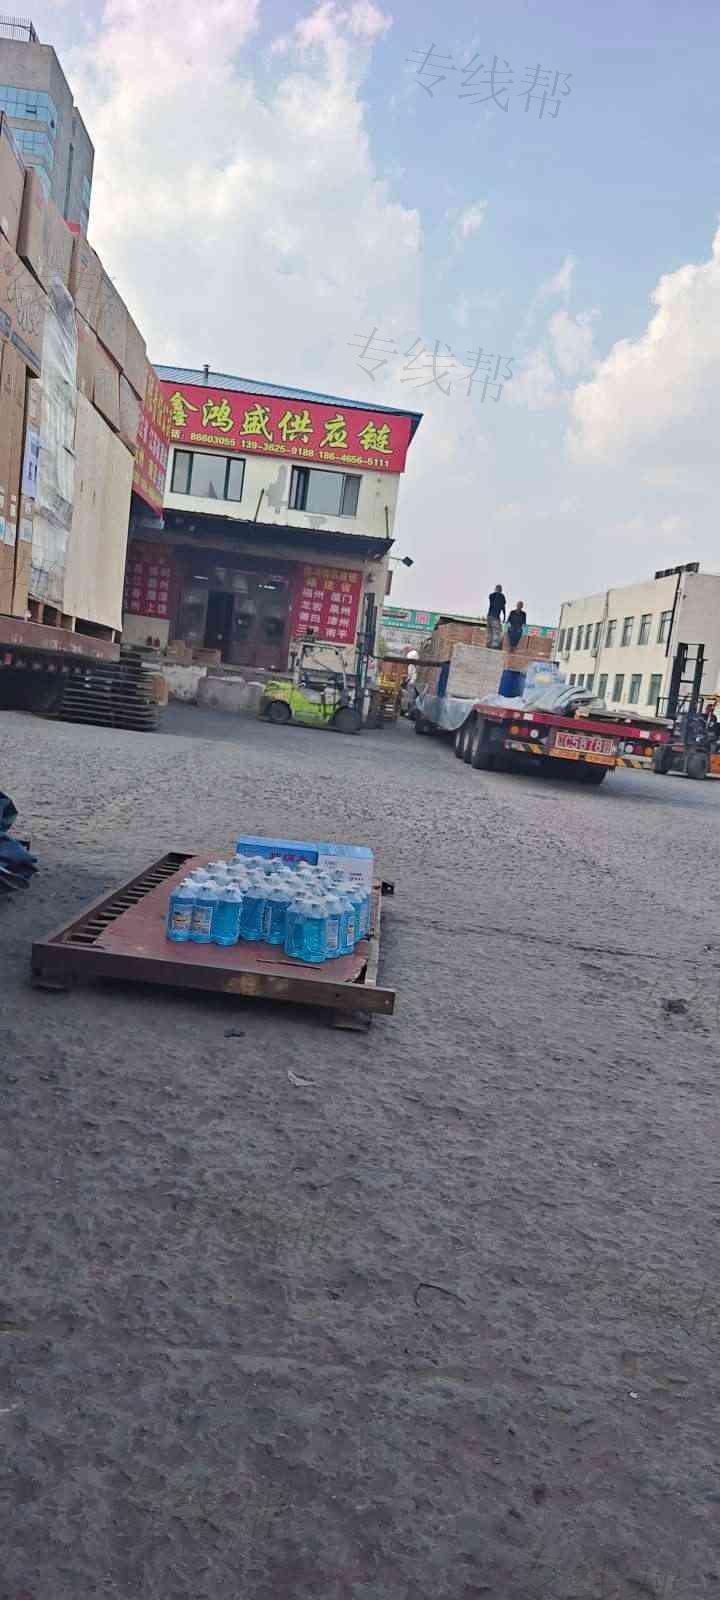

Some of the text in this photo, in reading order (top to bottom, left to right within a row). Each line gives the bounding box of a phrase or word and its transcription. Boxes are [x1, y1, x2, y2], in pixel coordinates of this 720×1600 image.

[167, 391, 394, 454] 鑫鸿盛供应链
